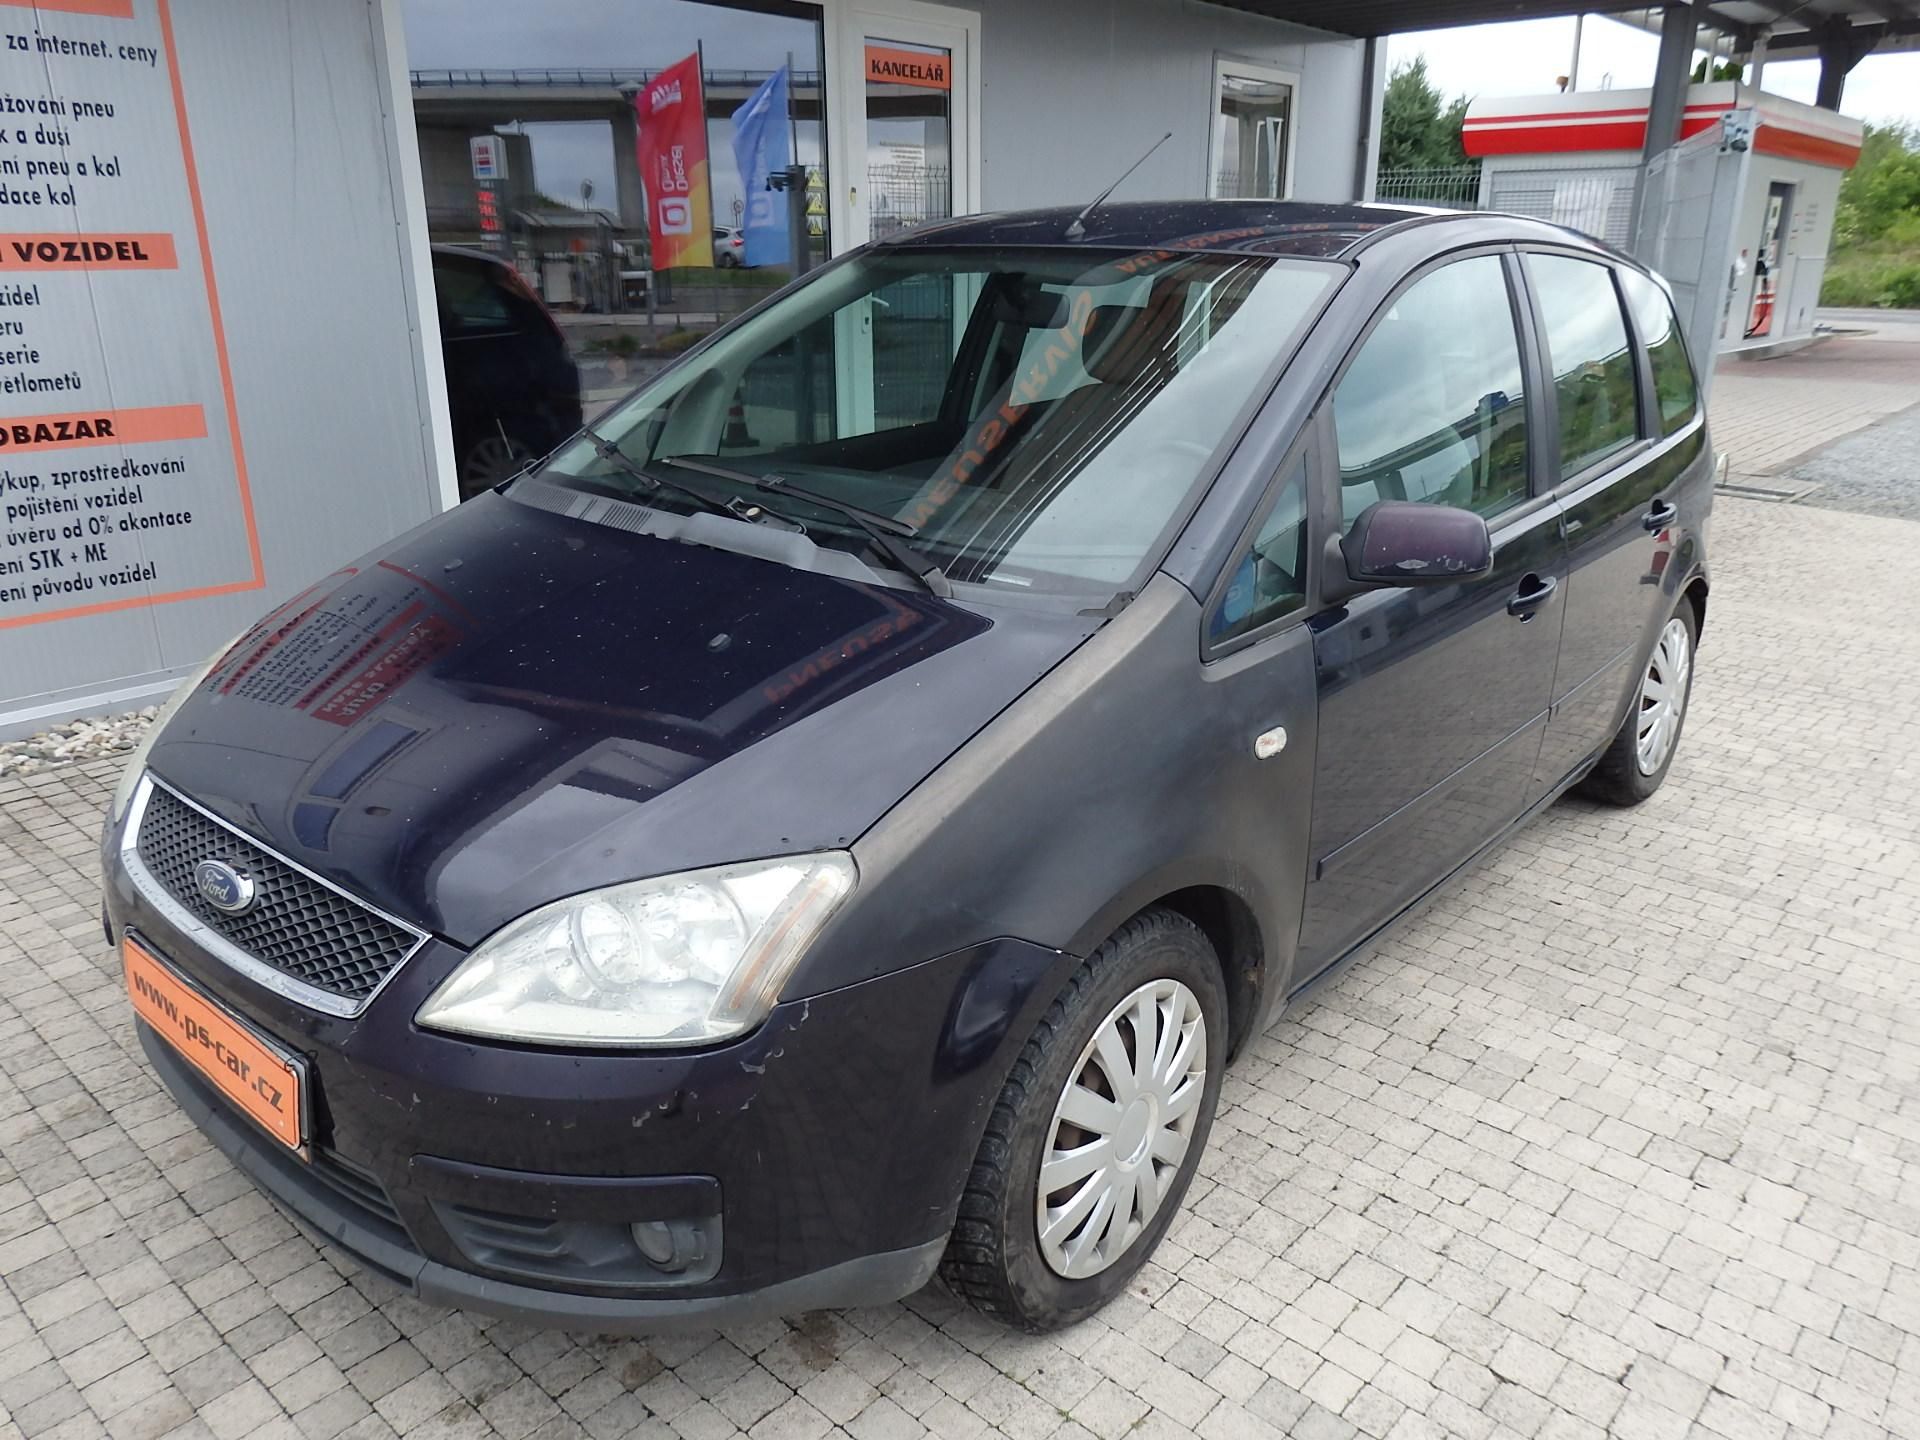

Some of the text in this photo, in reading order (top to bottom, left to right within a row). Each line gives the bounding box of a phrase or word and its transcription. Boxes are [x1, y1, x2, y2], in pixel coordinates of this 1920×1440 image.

[6, 29, 157, 68] za internet. ceny
[871, 59, 944, 82] KANCELÁŘ
[72, 101, 115, 121] pneu
[16, 129, 27, 144] a
[0, 154, 121, 180] ní pneu a kol
[46, 183, 76, 206] kol
[11, 241, 149, 263] VOZIDEL
[51, 456, 186, 490] zprostředkování
[7, 485, 143, 523] pojištění vozidel
[7, 510, 193, 547] úvěru od 0% akontace
[29, 548, 64, 571] STK
[85, 542, 108, 563] ME
[32, 572, 93, 602] původu
[99, 561, 157, 588] vozidel
[200, 868, 231, 901] Ford
[132, 969, 285, 1114] www.ps-car.cz
